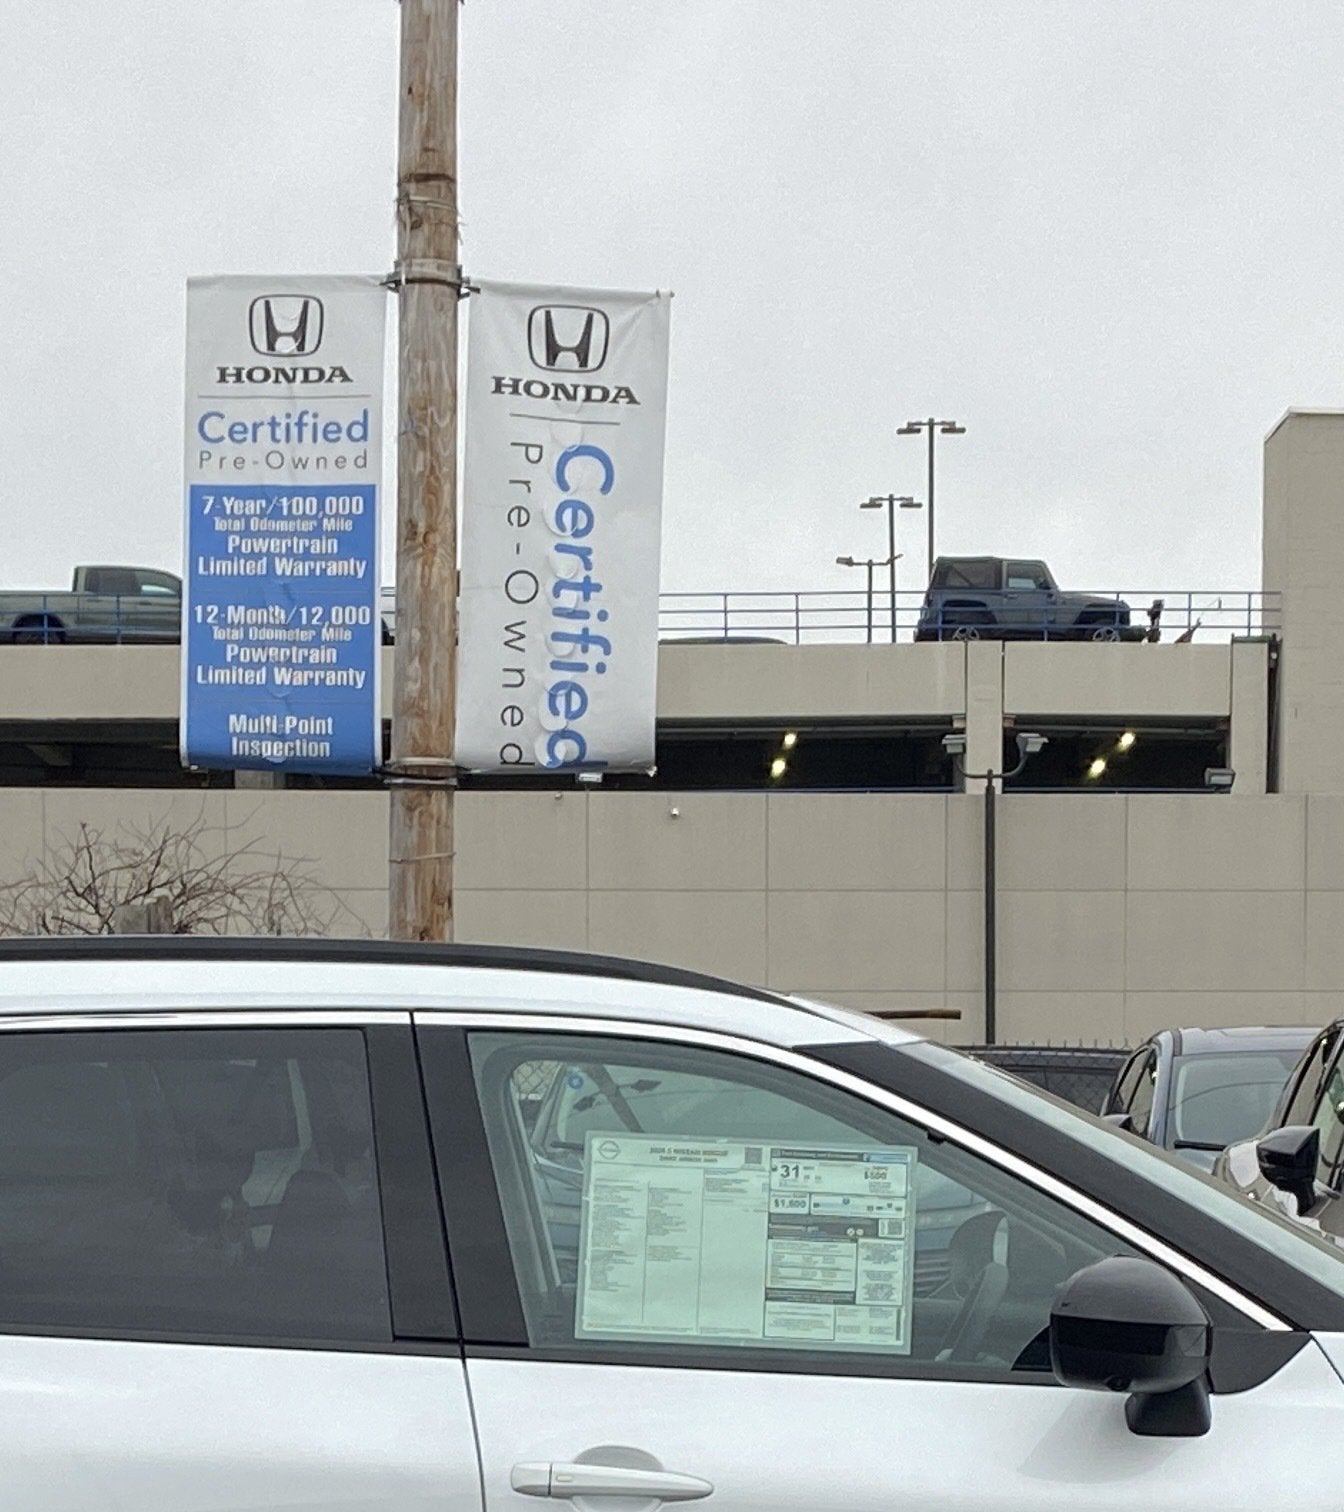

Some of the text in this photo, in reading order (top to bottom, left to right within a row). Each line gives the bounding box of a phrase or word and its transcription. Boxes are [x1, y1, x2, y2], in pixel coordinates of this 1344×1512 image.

[216, 366, 354, 385] HONDA
[490, 375, 642, 406] HONDA
[198, 407, 370, 445] Certified
[199, 448, 369, 471] Pre-Owned
[201, 495, 365, 518] 7-Year/100,000
[213, 516, 354, 533] Total Odometer Mile
[227, 534, 339, 555] Powertrain
[197, 556, 368, 579] Limited Warranty
[499, 441, 544, 767] Pre-Owned
[546, 444, 615, 769] Certified
[194, 604, 372, 628] 12-Month/12,000
[212, 625, 353, 642] Total Odometer Mile
[225, 643, 338, 664] Powertrain
[196, 665, 367, 689] Limited Warranty
[228, 713, 334, 736] Multi-Point
[231, 736, 331, 759] Inspection
